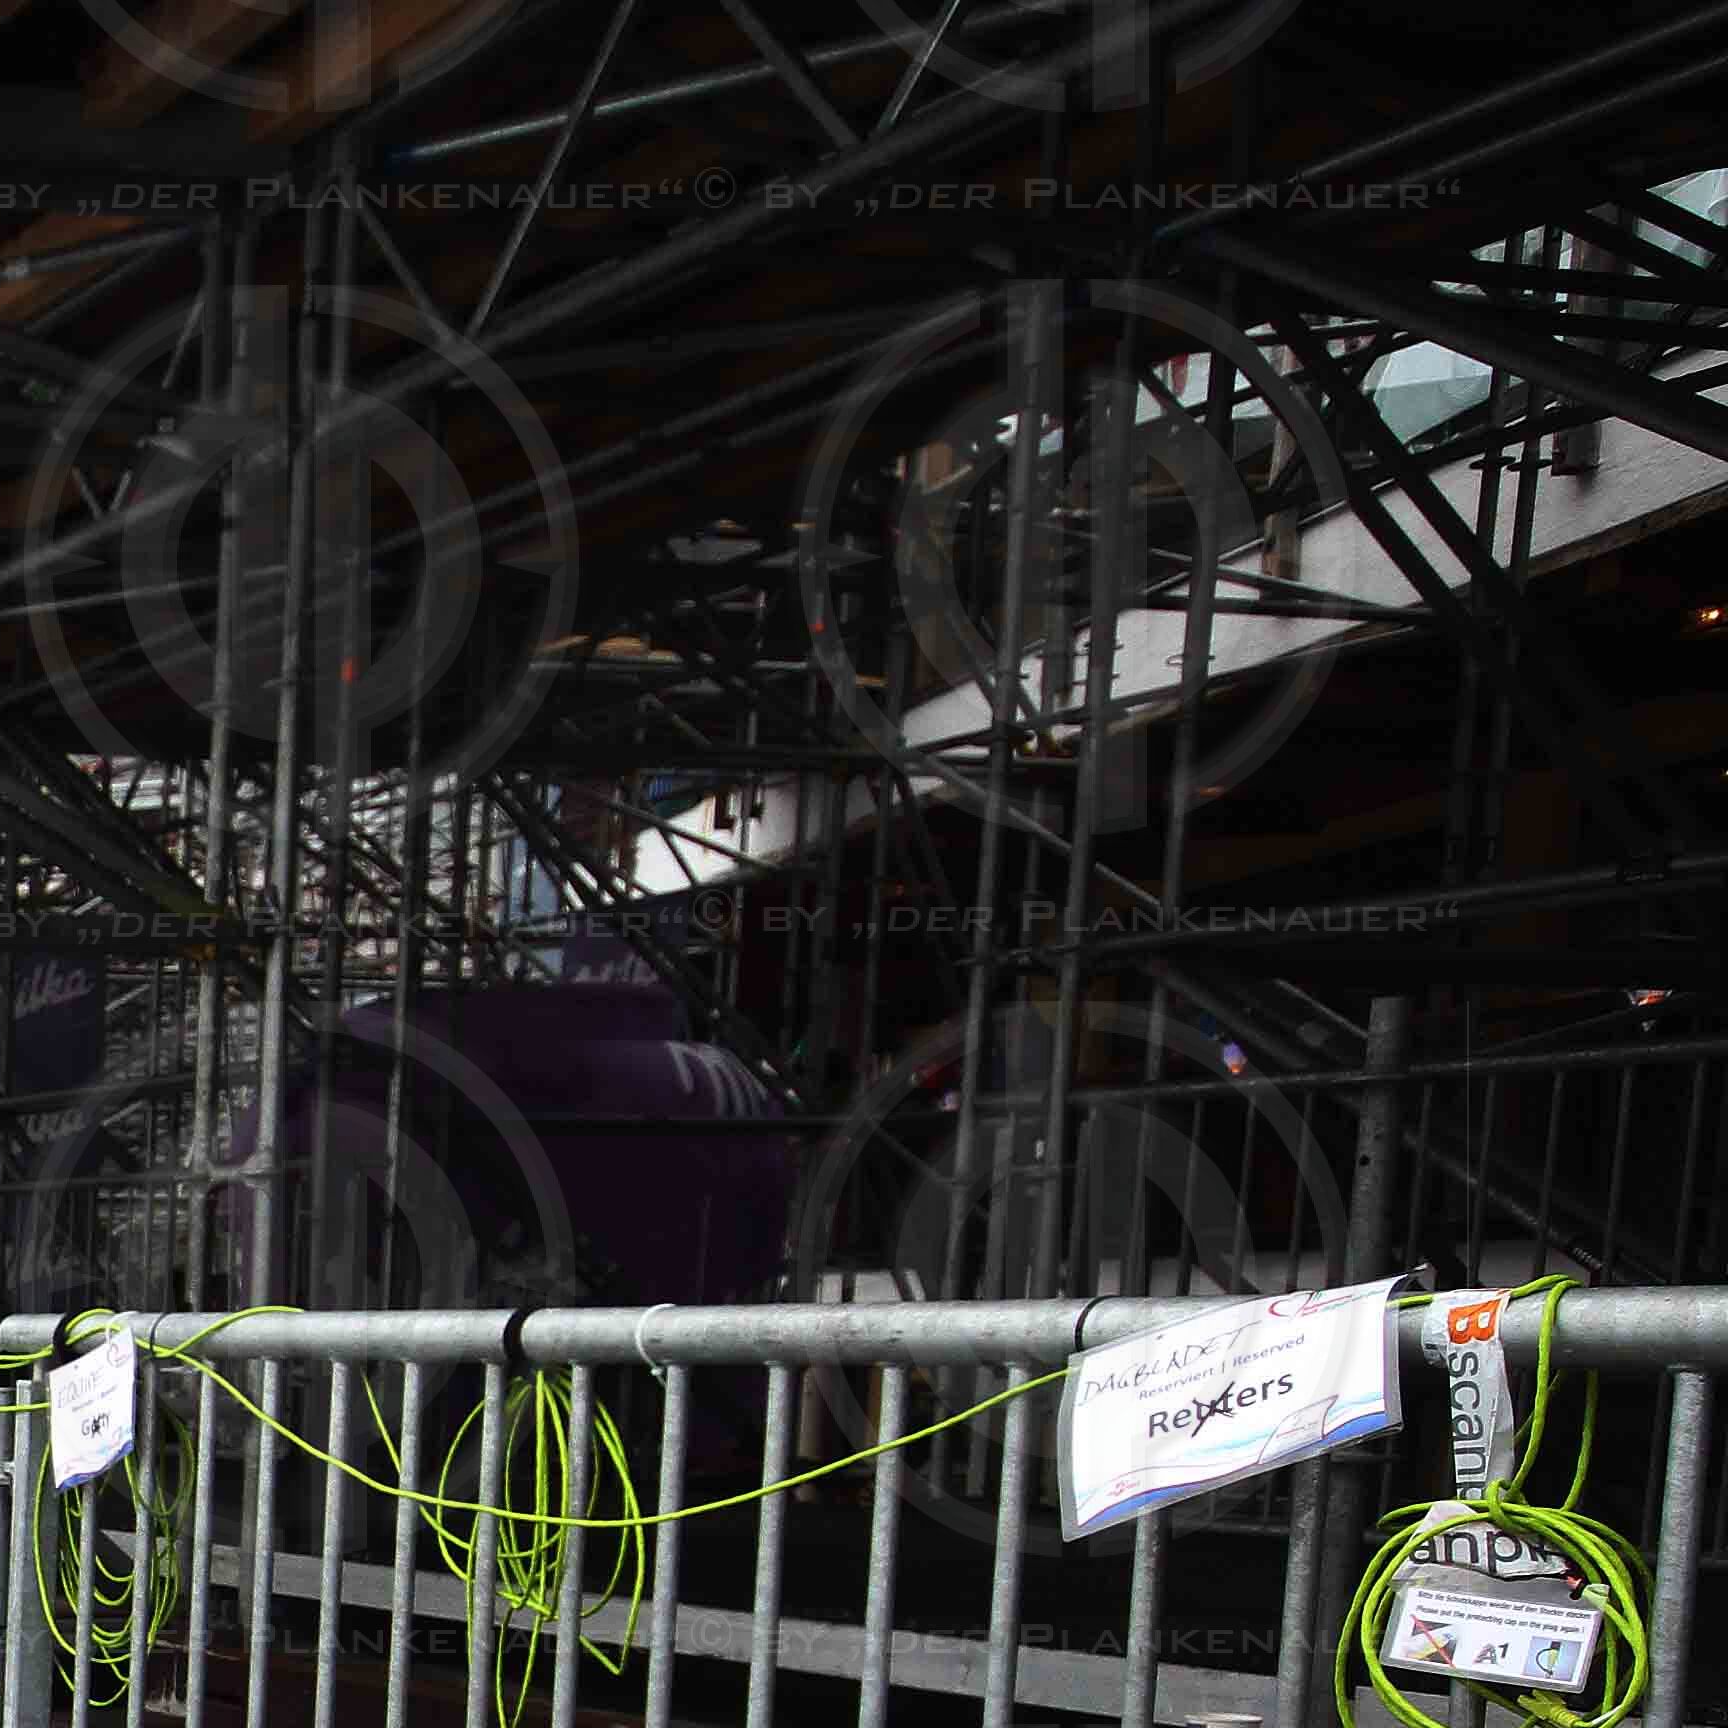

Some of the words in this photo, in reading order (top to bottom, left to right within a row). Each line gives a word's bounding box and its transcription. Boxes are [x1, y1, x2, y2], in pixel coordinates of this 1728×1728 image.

[1138, 1368, 1216, 1400] Reserviert
[1232, 1334, 1305, 1369] Reserved
[1147, 1373, 1295, 1438] Reuters
[1473, 1642, 1512, 1665] A1
